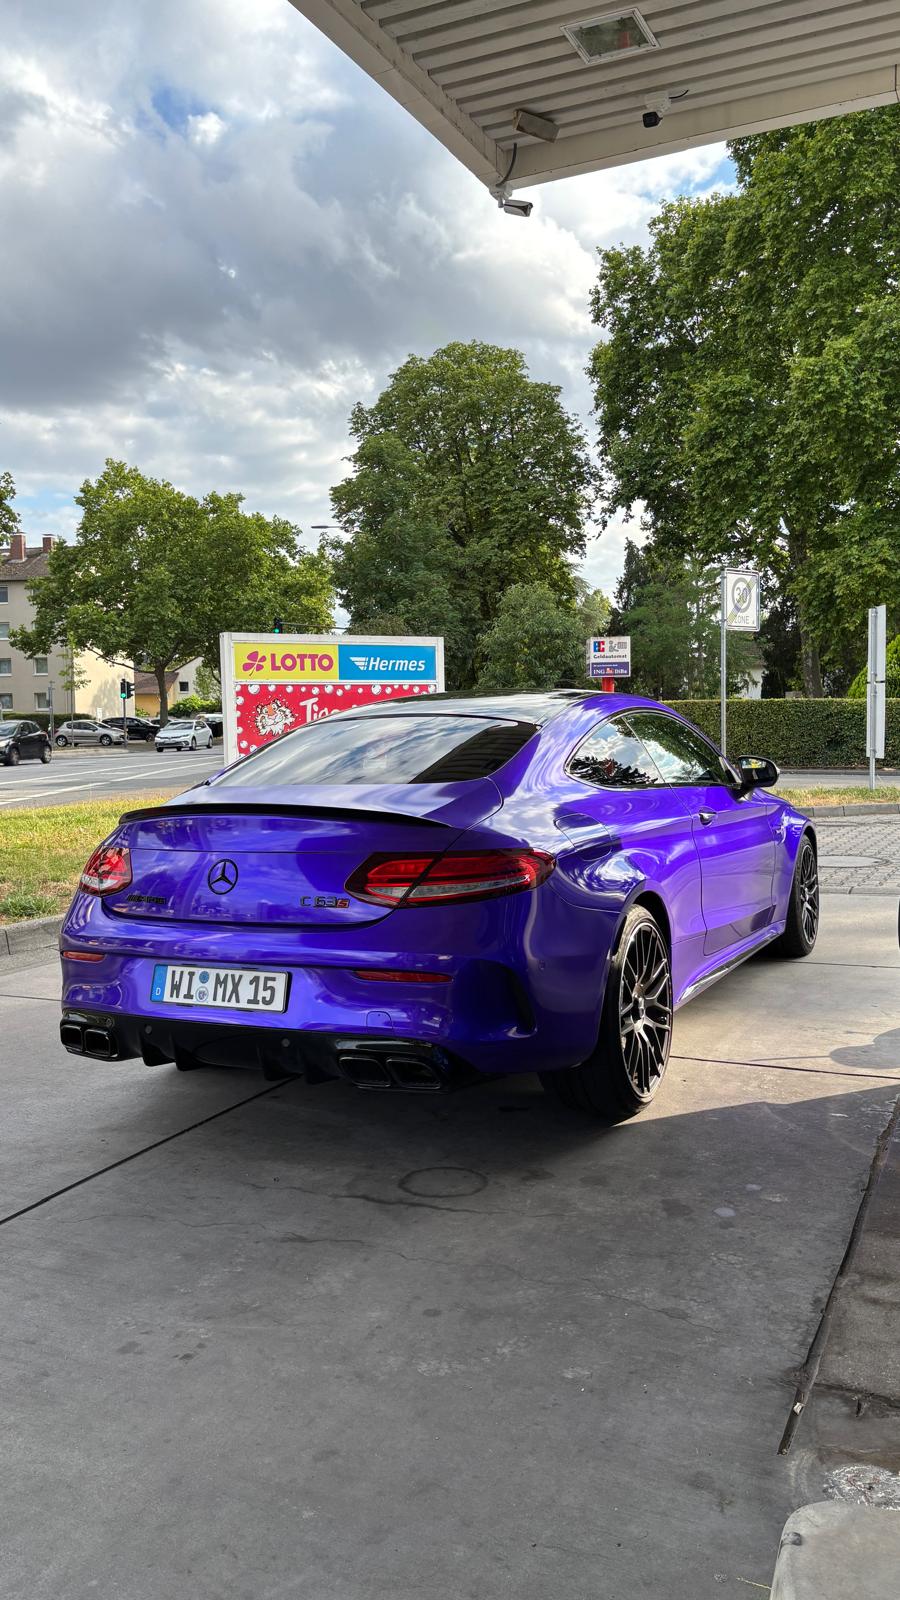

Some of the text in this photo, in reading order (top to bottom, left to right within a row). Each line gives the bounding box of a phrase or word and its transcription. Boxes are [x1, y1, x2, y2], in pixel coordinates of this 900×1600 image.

[735, 587, 748, 604] 30
[593, 640, 605, 652] EC
[270, 652, 334, 672] LOTTO
[368, 656, 426, 672] Hermes
[300, 896, 311, 907] C
[155, 987, 161, 996] D
[169, 970, 277, 1006] WI MX 15
